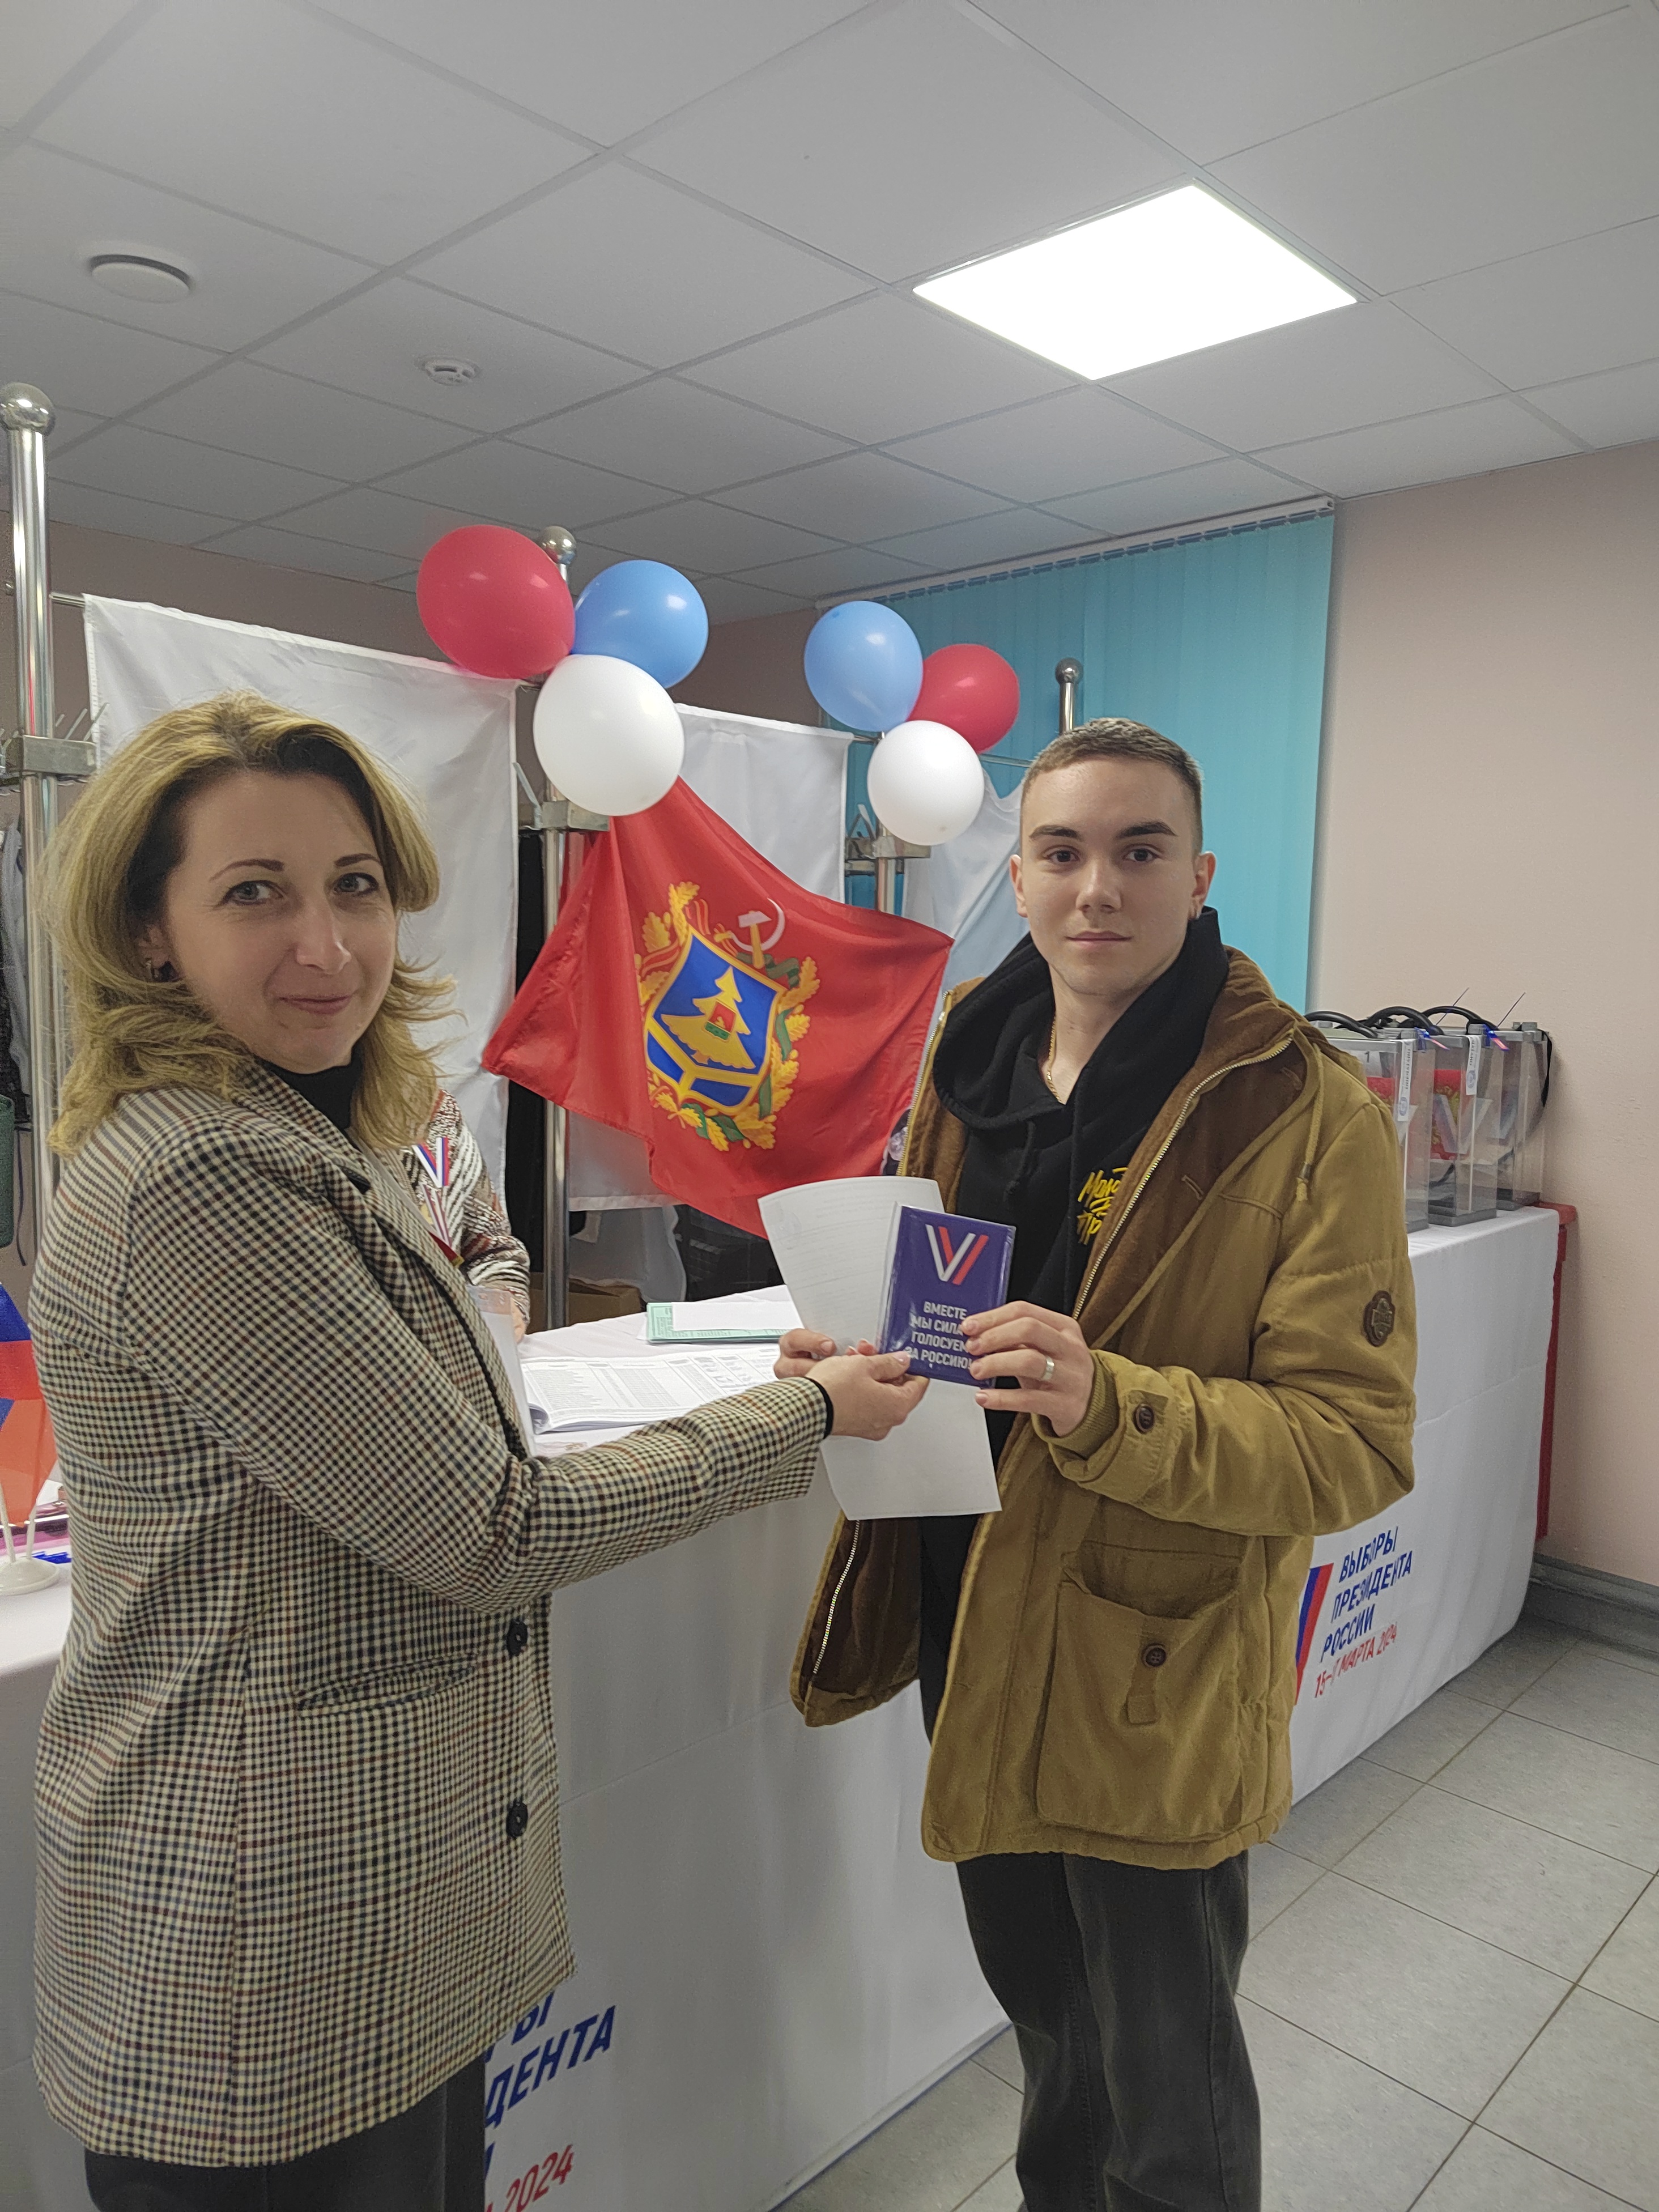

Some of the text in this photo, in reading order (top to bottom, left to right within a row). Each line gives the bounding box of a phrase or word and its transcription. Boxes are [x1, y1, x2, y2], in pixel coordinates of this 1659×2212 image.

[910, 1314, 933, 1330] МЫ
[923, 1301, 968, 1320] ВМЕСТЕ
[1338, 1525, 1398, 1583] ВЫБОРЫ
[1330, 1550, 1413, 1624] ПРЕЗИДЕНТА
[1320, 1603, 1376, 1664] РОССИИ
[484, 2005, 616, 2130] ДЕНТА
[505, 2143, 575, 2212] 2024
